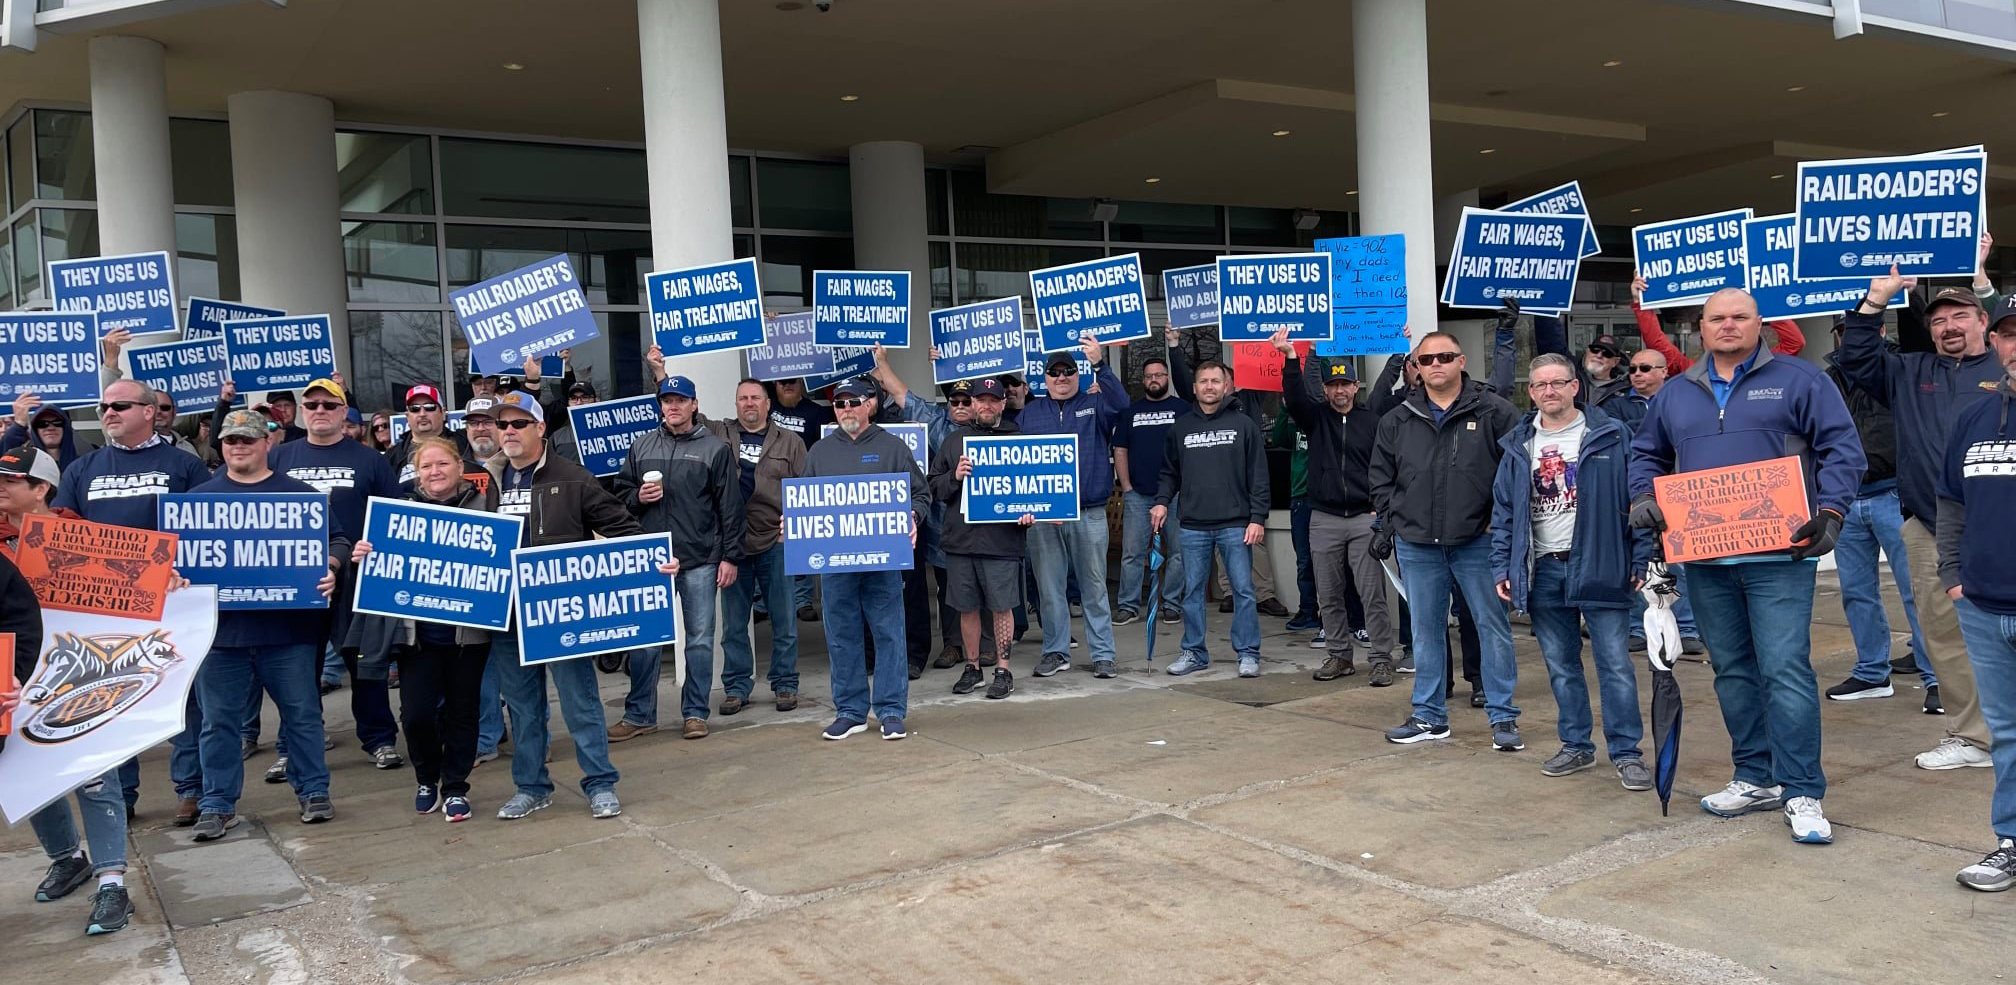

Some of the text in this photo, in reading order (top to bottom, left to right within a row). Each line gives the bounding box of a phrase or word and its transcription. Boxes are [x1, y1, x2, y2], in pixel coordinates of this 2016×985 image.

[1803, 168, 1978, 202] RAILROADER'S
[1479, 223, 1565, 251] FAIR WAGES,
[1644, 220, 1739, 251] THEY USE US
[1805, 211, 1972, 243] LIVES MATTER
[1362, 237, 1386, 253] 90%
[1765, 224, 1796, 252] FAI
[1336, 259, 1352, 270] my
[1460, 257, 1575, 280] FAIR TREATMENT
[1643, 260, 1673, 281] AND
[1676, 250, 1726, 275] ABUSE
[1860, 252, 1934, 267] SMART
[61, 261, 159, 287] THEY USE US
[1035, 263, 1138, 298] RAILROADER'S
[1172, 272, 1200, 288] THEY
[1227, 263, 1320, 285] THEY USE US
[1351, 269, 1367, 283] I
[1372, 270, 1400, 281] need
[1680, 276, 1726, 291] SMART
[1751, 263, 1790, 289] FAIR
[455, 261, 573, 319] RAILROADER'S
[662, 271, 743, 300] FAIR WAGES,
[827, 279, 896, 300] FAIR WAGES,
[1354, 288, 1383, 298] then
[96, 293, 145, 314] ABUSE
[148, 289, 169, 307] US
[1171, 291, 1218, 310] AND ABU
[1223, 293, 1328, 315] AND ABUSE US
[1804, 289, 1867, 305] SMART
[202, 306, 227, 322] FAIR
[467, 288, 584, 345] LIVES MATTER
[655, 299, 758, 332] FAIR TREATMENT
[816, 305, 907, 323] FAIR TREATMENT
[937, 306, 1013, 334] THEY USE US
[1041, 293, 1141, 327] LIVES MATTER
[23, 321, 85, 343] USE US
[233, 326, 271, 345] THEY
[273, 324, 301, 341] USE
[304, 323, 322, 339] US
[694, 331, 737, 345] SMART
[784, 320, 805, 336] USE
[848, 331, 886, 339] SMART
[519, 329, 576, 357] SMART
[751, 338, 813, 361] AND ABUSE
[937, 341, 961, 359] AND
[963, 334, 1003, 355] ABUSE
[1004, 331, 1020, 349] US
[1241, 345, 1263, 356] 10%
[10, 354, 69, 374] ABUSE
[71, 353, 96, 373] US
[137, 351, 173, 370] THEY
[177, 347, 206, 365] USE
[232, 348, 331, 371] AND ABUSE US
[781, 362, 814, 371] SMART
[967, 359, 1003, 371] SMART
[269, 373, 312, 384] SMART
[1332, 365, 1346, 376] M
[14, 383, 69, 394] SMART
[172, 371, 217, 392] ABUSE
[585, 404, 658, 429] FAIR WAGES,
[1133, 411, 1176, 422] SMART
[580, 437, 607, 456] FAIR
[1184, 431, 1237, 445] SMART
[968, 445, 1074, 466] RAILROADER'S
[89, 474, 170, 490] SMART
[971, 475, 1074, 495] LIVES MATTER
[1688, 468, 1764, 491] RESPECT
[786, 480, 907, 508] RAILROADER'S
[1688, 482, 1767, 500] OUR RIGHTS
[1007, 504, 1051, 513] SMART
[1703, 497, 1731, 507] WORK
[164, 501, 324, 530] RAILROADER'S
[787, 511, 908, 539] LIVES MATTER
[54, 521, 148, 544] COMMUNITY!
[387, 513, 497, 558] FAIR WAGES,
[1690, 527, 1711, 536] HELP
[1713, 526, 1728, 534] OUR
[1729, 522, 1768, 532] WORKERS
[1692, 527, 1781, 546] PROTECT YOUR
[51, 532, 146, 553] PROTECT YOUR
[63, 544, 104, 554] WORKERS
[1693, 535, 1782, 557] COMMUNITY!
[173, 539, 323, 568] IVES MATTER
[829, 553, 890, 566] SMART
[364, 552, 511, 594] FAIR TREATMENT
[519, 546, 668, 588] RAILROADER'S
[49, 580, 132, 598] OUR RIGHTS
[218, 587, 298, 602] SMART
[47, 590, 130, 611] RESPECT
[411, 594, 473, 613] SMART
[525, 585, 668, 628] LIVES MATTER
[578, 625, 640, 644] SMART
